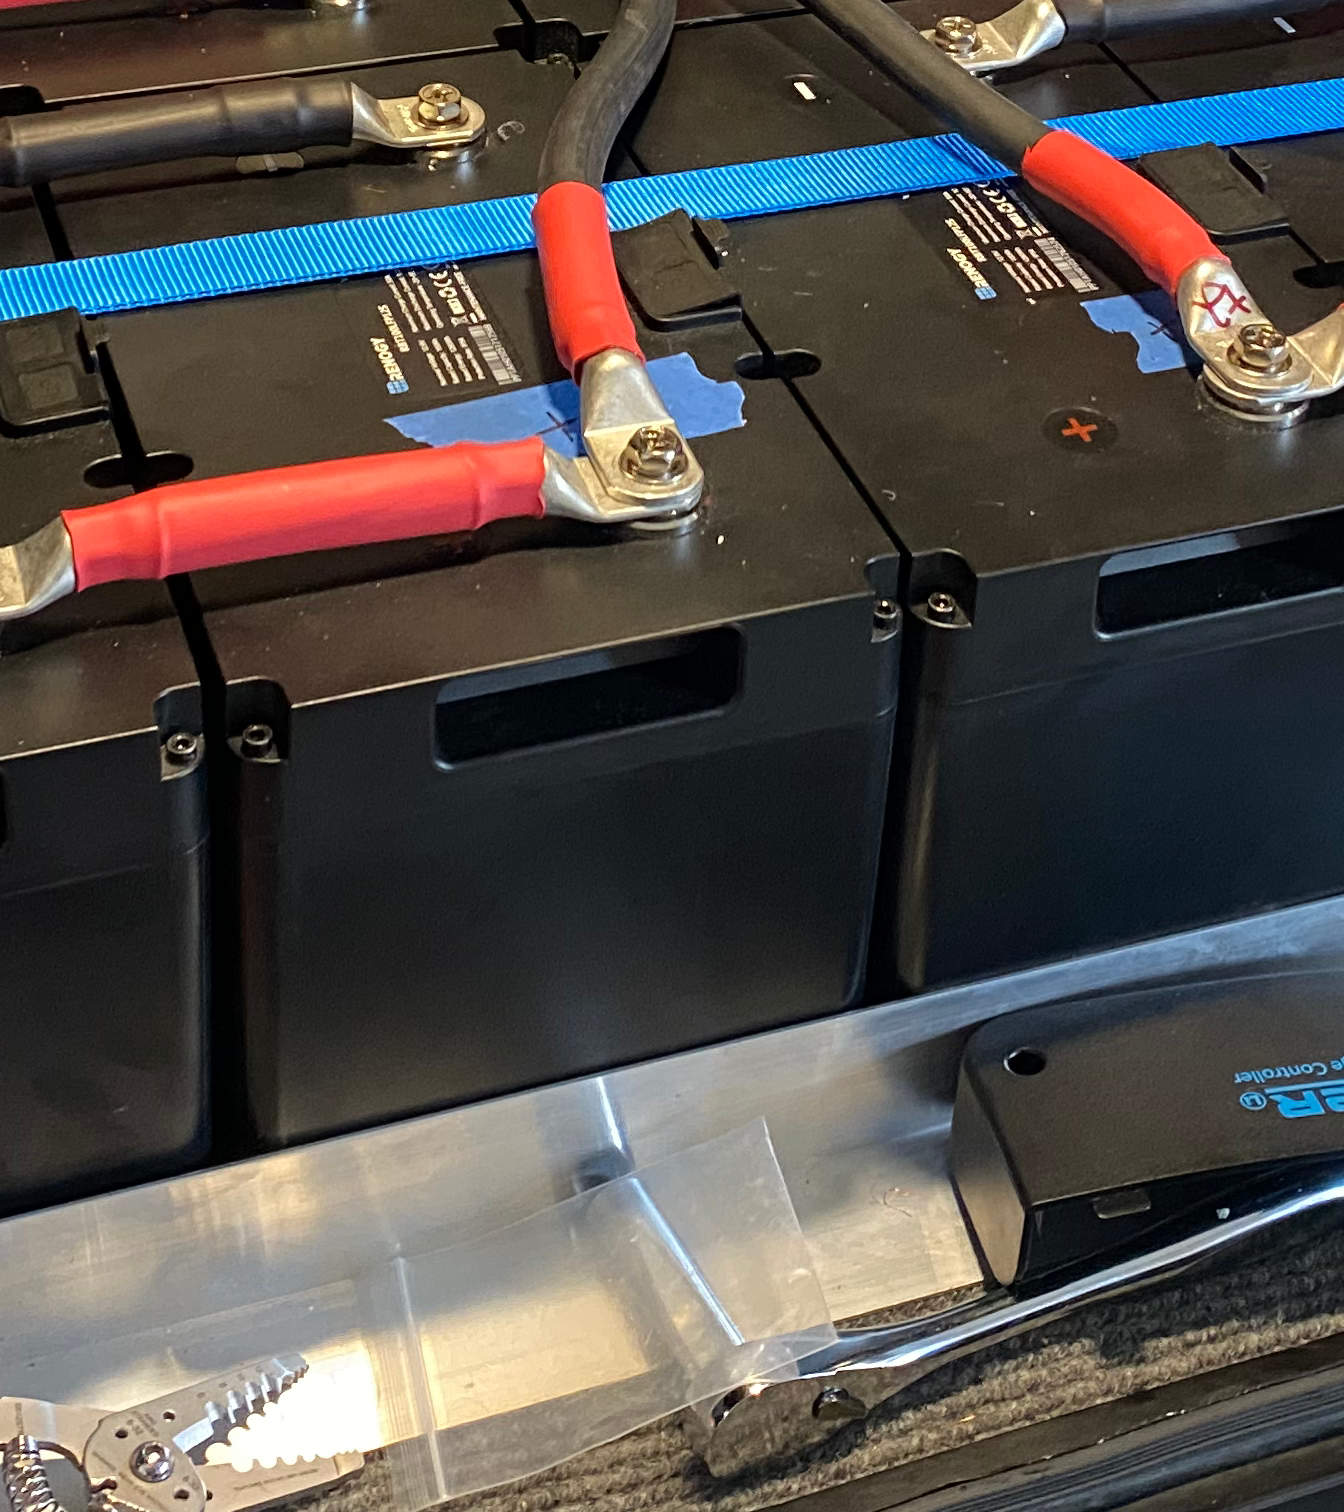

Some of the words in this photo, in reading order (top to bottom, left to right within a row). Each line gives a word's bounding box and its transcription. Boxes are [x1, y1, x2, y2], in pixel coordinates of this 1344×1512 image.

[946, 247, 990, 289] RENOGY
[369, 336, 405, 381] RENOGY
[1233, 1061, 1329, 1086] Controller
